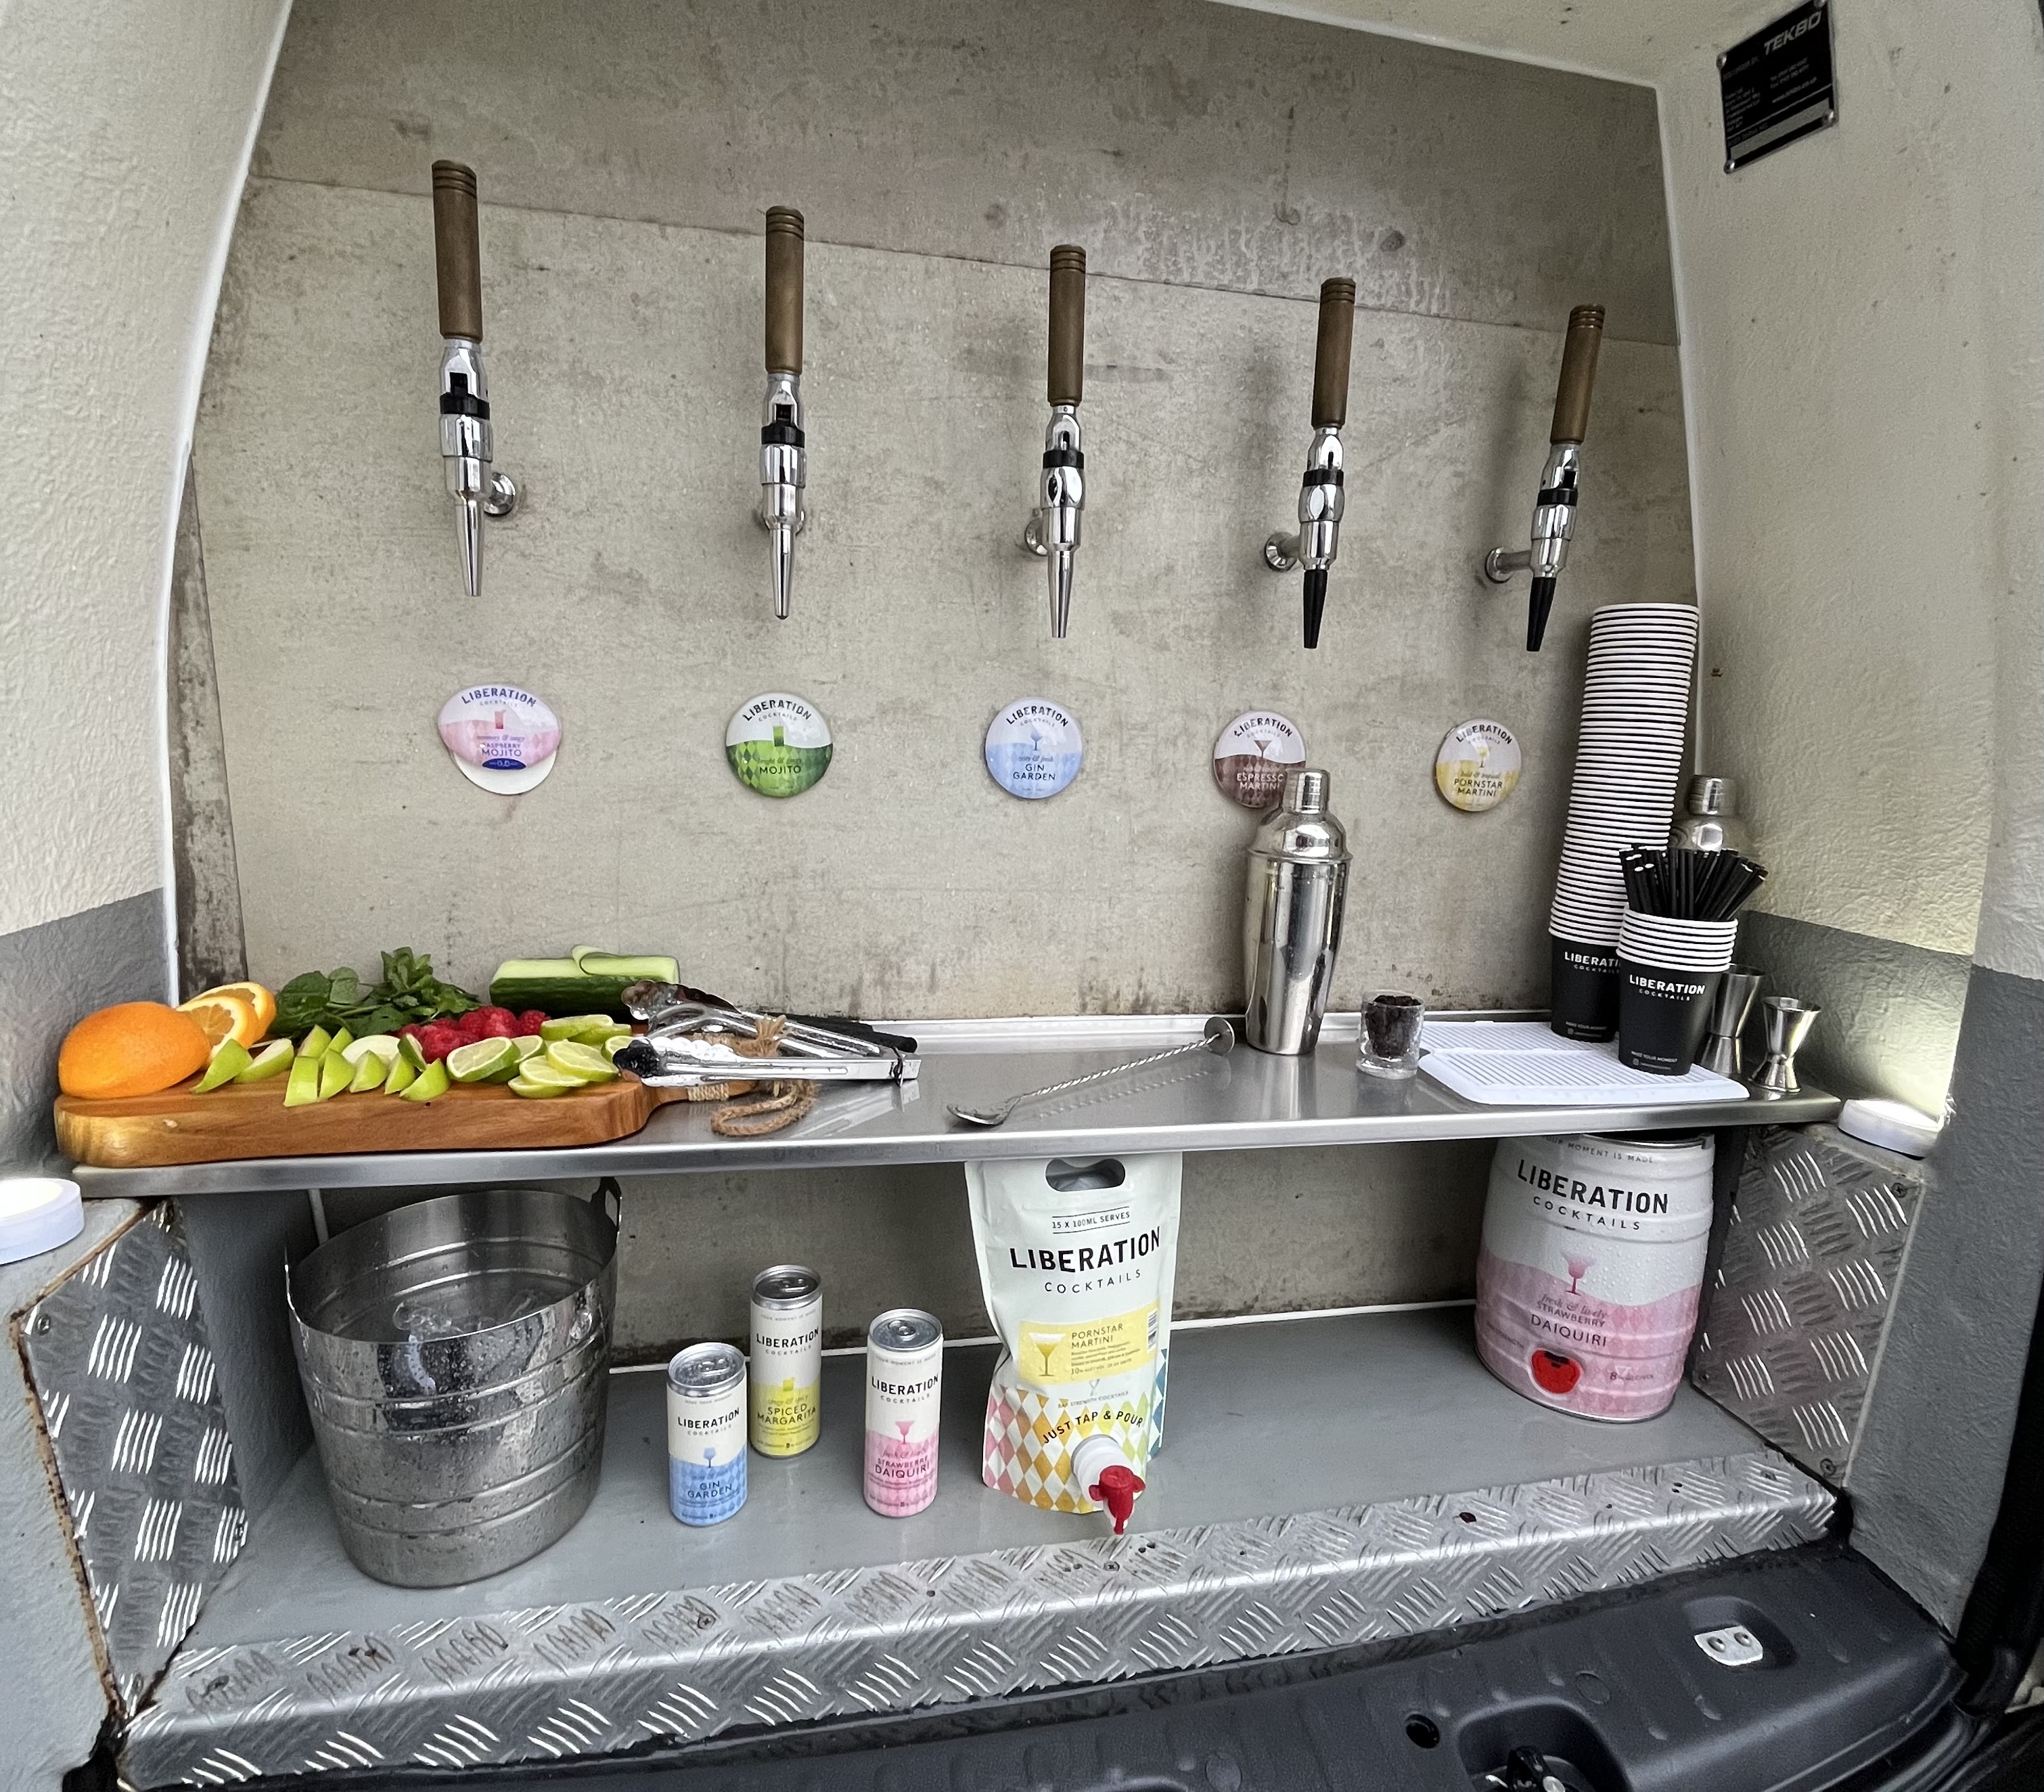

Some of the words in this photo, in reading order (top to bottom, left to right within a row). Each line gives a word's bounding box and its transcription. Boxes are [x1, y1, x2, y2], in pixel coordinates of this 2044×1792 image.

[461, 688, 537, 707] LIBERATION
[742, 700, 812, 721] LIBERATION
[1006, 706, 1069, 727] LIBERATION
[1233, 717, 1292, 737] LIBERATION
[1456, 725, 1512, 744] LIBERATION
[482, 748, 522, 757] MOJITO
[759, 765, 801, 774] MOJITO
[1013, 771, 1055, 780] GARDEN
[1025, 763, 1045, 771] GIN
[1240, 782, 1280, 790] MARTINI
[1454, 778, 1503, 788] PORNSTAR
[1457, 788, 1497, 797] MARTINI
[1629, 975, 1705, 995] LIBERATION
[1639, 989, 1690, 1002] COCKTAILS
[1568, 1142, 1608, 1157] MOMENT
[1627, 1155, 1653, 1163] MADE
[1518, 1159, 1668, 1214] LIBERATION
[1072, 1217, 1097, 1228] 100ML
[1100, 1211, 1130, 1223] SERVES
[1533, 1196, 1640, 1230] COCKTAILS
[1009, 1226, 1160, 1273] LIBERATION
[1045, 1269, 1141, 1294] COCKTAILS
[1537, 1300, 1606, 1328] STRAWBERRY
[1566, 1301, 1579, 1312] &
[756, 1326, 819, 1348] LIBERATION
[1072, 1323, 1124, 1340] PORNSTAR
[1531, 1314, 1607, 1347] DAIQUIRI
[765, 1345, 811, 1356] COCKTAILS
[1071, 1335, 1113, 1349] MARTINI
[871, 1373, 939, 1395] LIBERATION
[880, 1393, 930, 1404] COCKTAILS
[1098, 1391, 1129, 1402] COCKTAILS
[677, 1407, 740, 1429] LIBERATION
[757, 1407, 816, 1425] MARGARITA
[767, 1404, 807, 1416] SPICED
[1042, 1420, 1071, 1444] JUST
[1075, 1411, 1099, 1425] TAP
[1104, 1410, 1112, 1420] &
[1116, 1410, 1143, 1428] POUR
[875, 1462, 930, 1479] DAIQUIRI
[878, 1456, 928, 1469] STRAWBERRY
[687, 1483, 732, 1498] GARDEN
[700, 1480, 720, 1490] GIN
